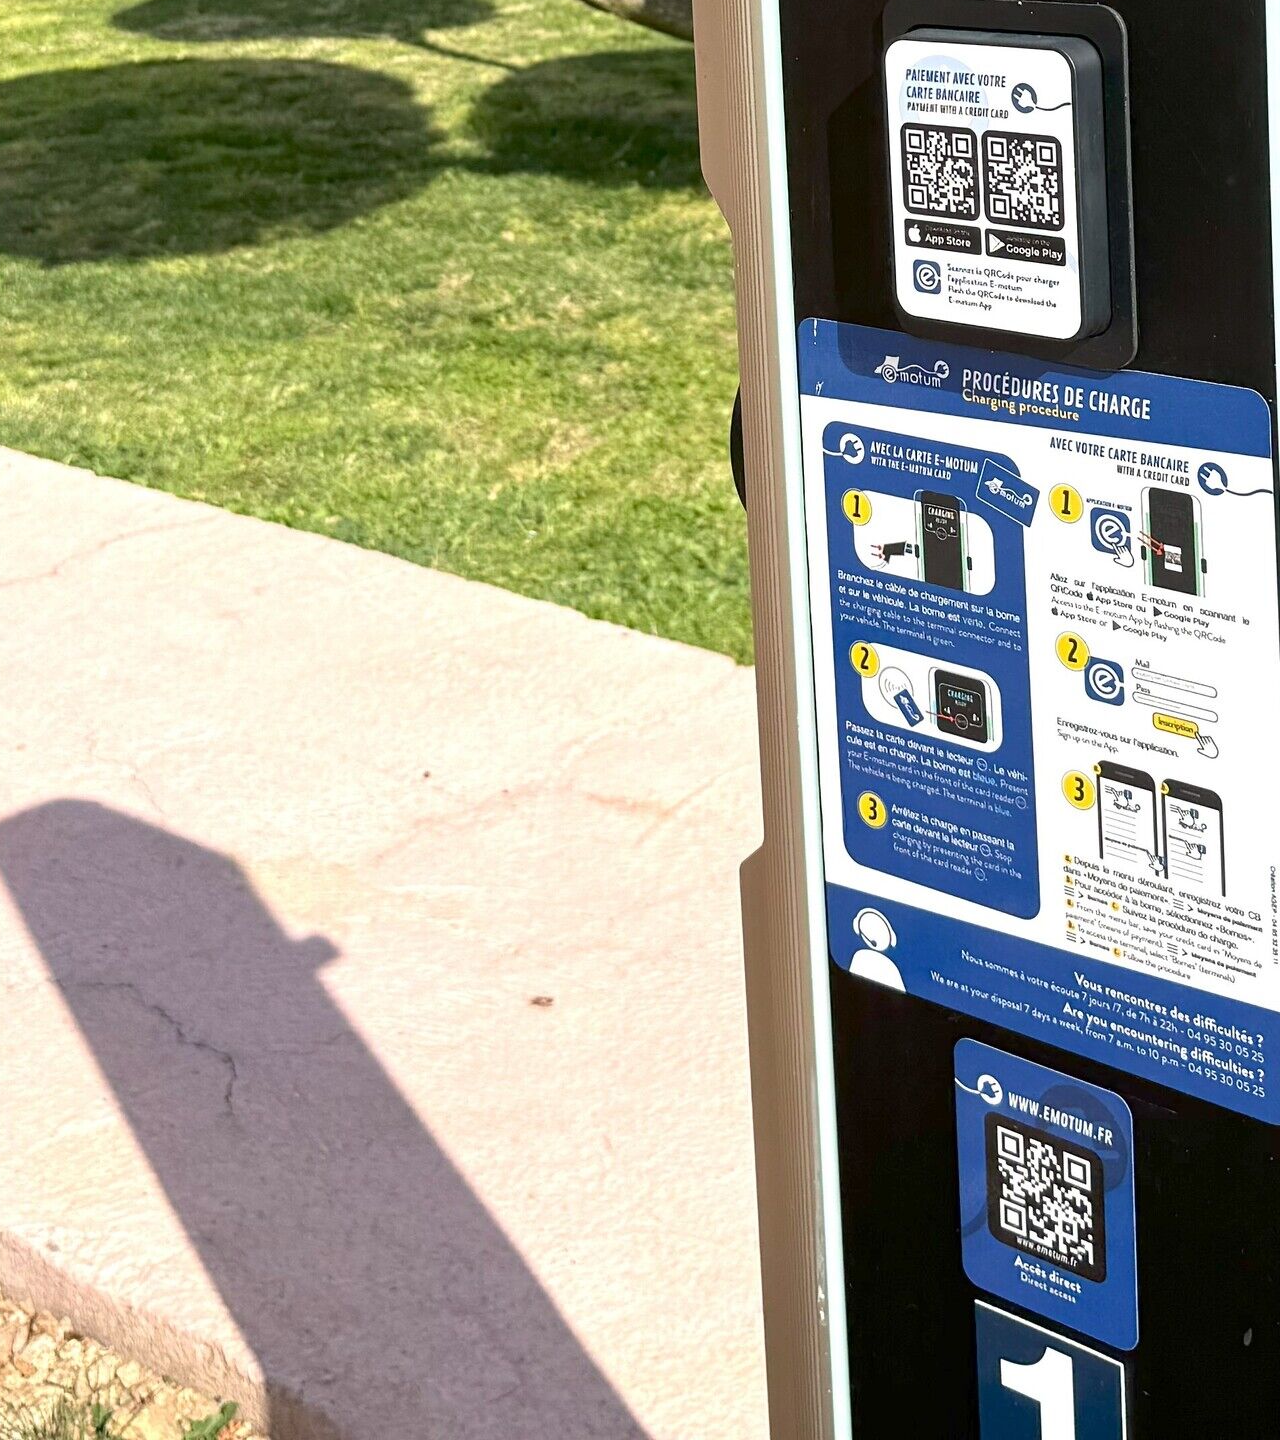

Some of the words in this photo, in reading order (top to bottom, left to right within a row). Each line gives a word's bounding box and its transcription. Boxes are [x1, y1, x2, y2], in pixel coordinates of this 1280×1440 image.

[906, 68, 951, 84] PAIEMENT
[953, 72, 975, 85] AVEC
[977, 74, 1006, 88] VOTRE
[906, 86, 933, 100] CARTE
[936, 88, 980, 103] BANCAIRE
[907, 102, 938, 113] PAYMENT
[991, 108, 1009, 119] CARD
[925, 234, 944, 246] App
[946, 236, 971, 248] Store
[1006, 244, 1040, 258] Google
[1042, 248, 1063, 261] Play
[961, 369, 1059, 404] PROCÉDURES
[1063, 386, 1084, 408] DE
[1088, 390, 1151, 419] CHARGE
[962, 388, 1016, 415] Charging
[1019, 402, 1079, 421] procedure
[870, 441, 891, 456] AVEC
[893, 445, 903, 458] LA
[905, 448, 932, 464] CARTE
[934, 453, 977, 473] E-MOTUM
[1049, 436, 1072, 451] AVEC
[1075, 441, 1104, 457] VOTRE
[1107, 446, 1137, 463] CARTE
[1140, 452, 1189, 473] BANCAIRE
[1117, 464, 1134, 476] WITH
[1143, 469, 1167, 482] CREDIT
[1171, 474, 1189, 486] CARD
[852, 494, 861, 517] 1
[1061, 489, 1071, 515] 1
[860, 645, 870, 670] 2
[1067, 637, 1078, 663] 2
[1073, 776, 1085, 802] 3
[868, 795, 878, 820] 3
[961, 949, 982, 965] Nous
[984, 960, 1017, 977] sommes
[1026, 974, 1048, 988] votre
[1050, 980, 1079, 999] écoute
[1081, 990, 1086, 1001] 7
[1088, 992, 1110, 1009] jours
[1126, 1005, 1136, 1018] de
[1138, 1010, 1150, 1023] 7h
[1159, 1017, 1177, 1033] 22h
[1187, 1027, 1200, 1041] 04
[1203, 1033, 1216, 1046] 95
[1218, 1038, 1232, 1052] 30
[1235, 1044, 1248, 1058] 05
[1251, 1049, 1264, 1063] 25
[1074, 972, 1102, 993] Vous
[1105, 985, 1167, 1015] rencontrez
[1169, 1004, 1189, 1023] des
[1192, 1012, 1253, 1045] difficultés
[1256, 1033, 1264, 1049] ?
[930, 971, 944, 984] We
[946, 979, 958, 989] are
[960, 984, 968, 993] at
[970, 987, 989, 1000] your
[990, 992, 1022, 1012] disposal
[1024, 1003, 1030, 1014] 7
[1031, 1006, 1050, 1024] days
[1108, 1033, 1114, 1044] 7
[1136, 1045, 1146, 1056] to
[1148, 1048, 1158, 1060] 10
[1188, 1061, 1201, 1076] 04
[1204, 1067, 1217, 1081] 95
[1219, 1073, 1233, 1087] 30
[1236, 1078, 1249, 1093] 05
[1252, 1084, 1265, 1098] 25
[1062, 1000, 1083, 1019] Are
[1086, 1012, 1107, 1028] you
[1110, 1020, 1187, 1061] encountering
[1190, 1045, 1254, 1079] difficulties
[1257, 1068, 1265, 1083] ?
[1007, 1091, 1113, 1146] WWW.EMOTUM.FR
[1016, 1236, 1078, 1269] www.emotum.fr
[1014, 1255, 1046, 1281] Accès
[1048, 1266, 1081, 1294] direct
[1020, 1272, 1047, 1295] Direct
[1049, 1284, 1076, 1304] access
[999, 1346, 1076, 1440] 1
